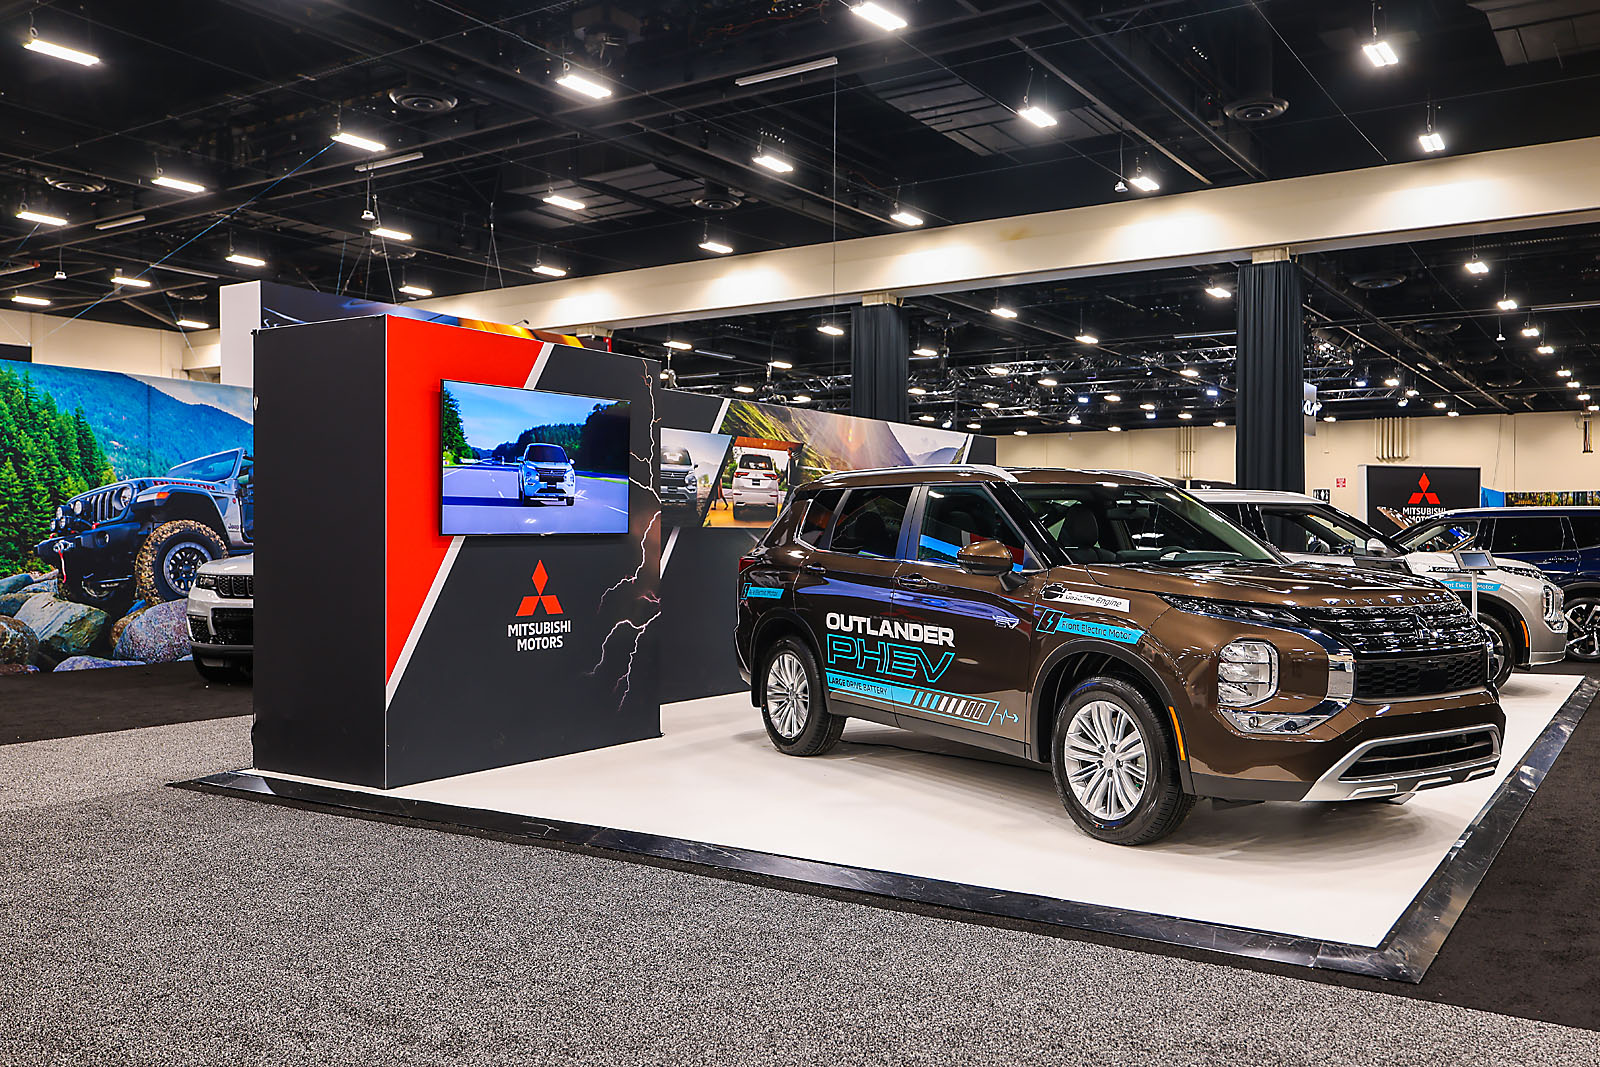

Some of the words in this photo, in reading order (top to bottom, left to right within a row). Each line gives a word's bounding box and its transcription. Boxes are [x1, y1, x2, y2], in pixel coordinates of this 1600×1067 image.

[1095, 596, 1123, 608] Engine
[507, 620, 571, 637] MITSUBISHI
[825, 612, 956, 648] OUTLANDER
[1062, 620, 1080, 631] Front
[1081, 624, 1107, 636] Electric
[1108, 629, 1132, 640] Motor
[516, 636, 564, 652] MOTORS
[826, 633, 956, 683] PHEV
[828, 675, 846, 688] LARGE
[846, 679, 862, 691] DRIVE
[862, 682, 888, 697] BATTERY
